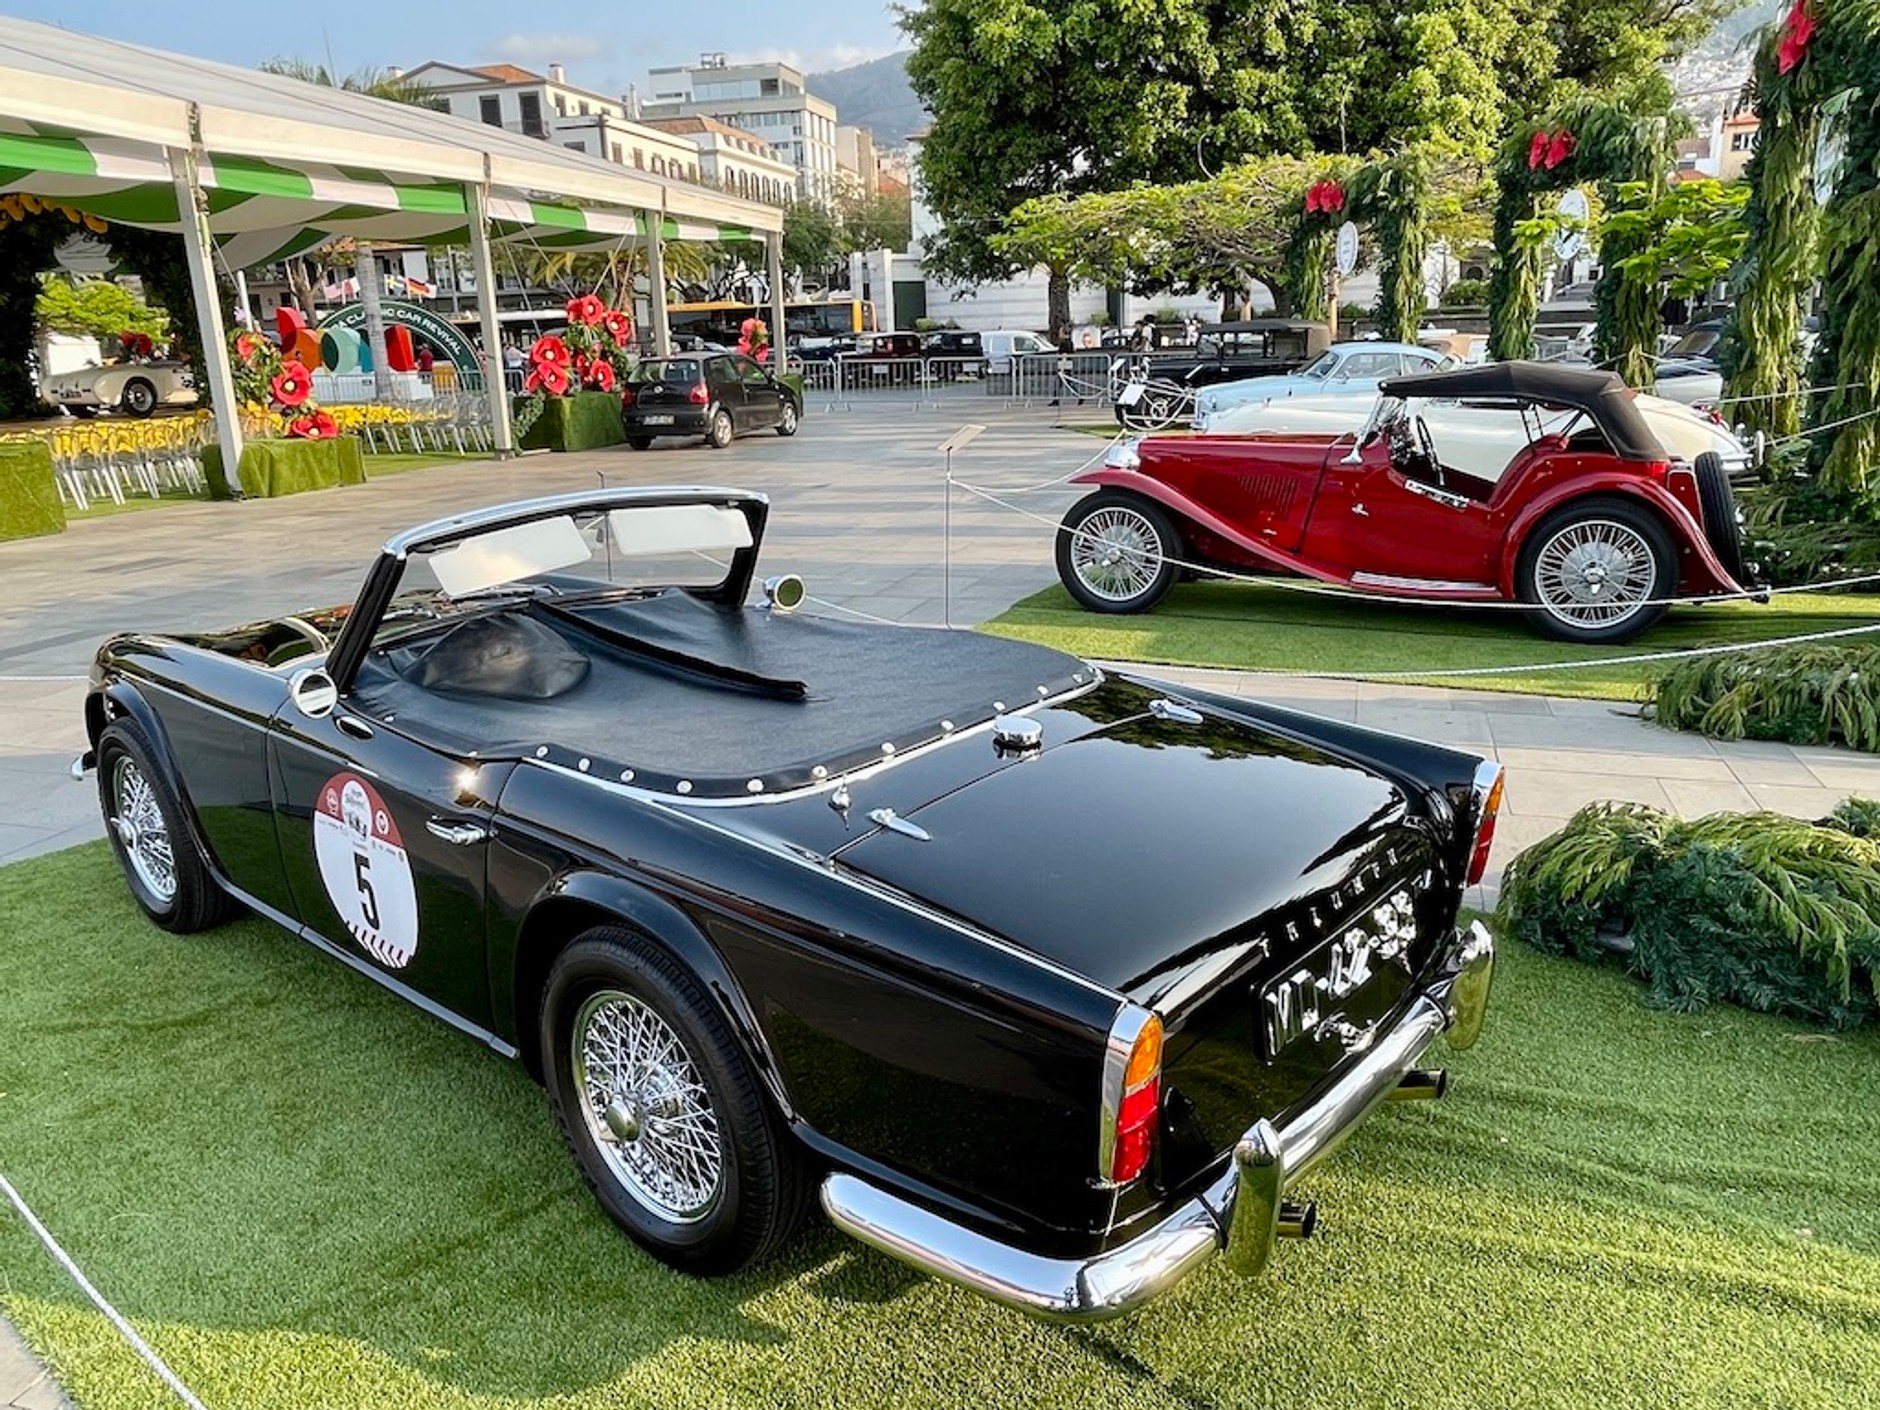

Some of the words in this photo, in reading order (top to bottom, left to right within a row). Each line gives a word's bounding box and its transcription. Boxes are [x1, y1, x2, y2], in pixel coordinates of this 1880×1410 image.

[396, 310, 422, 323] CAR
[422, 318, 462, 355] REVIVAL
[354, 851, 380, 931] 5
